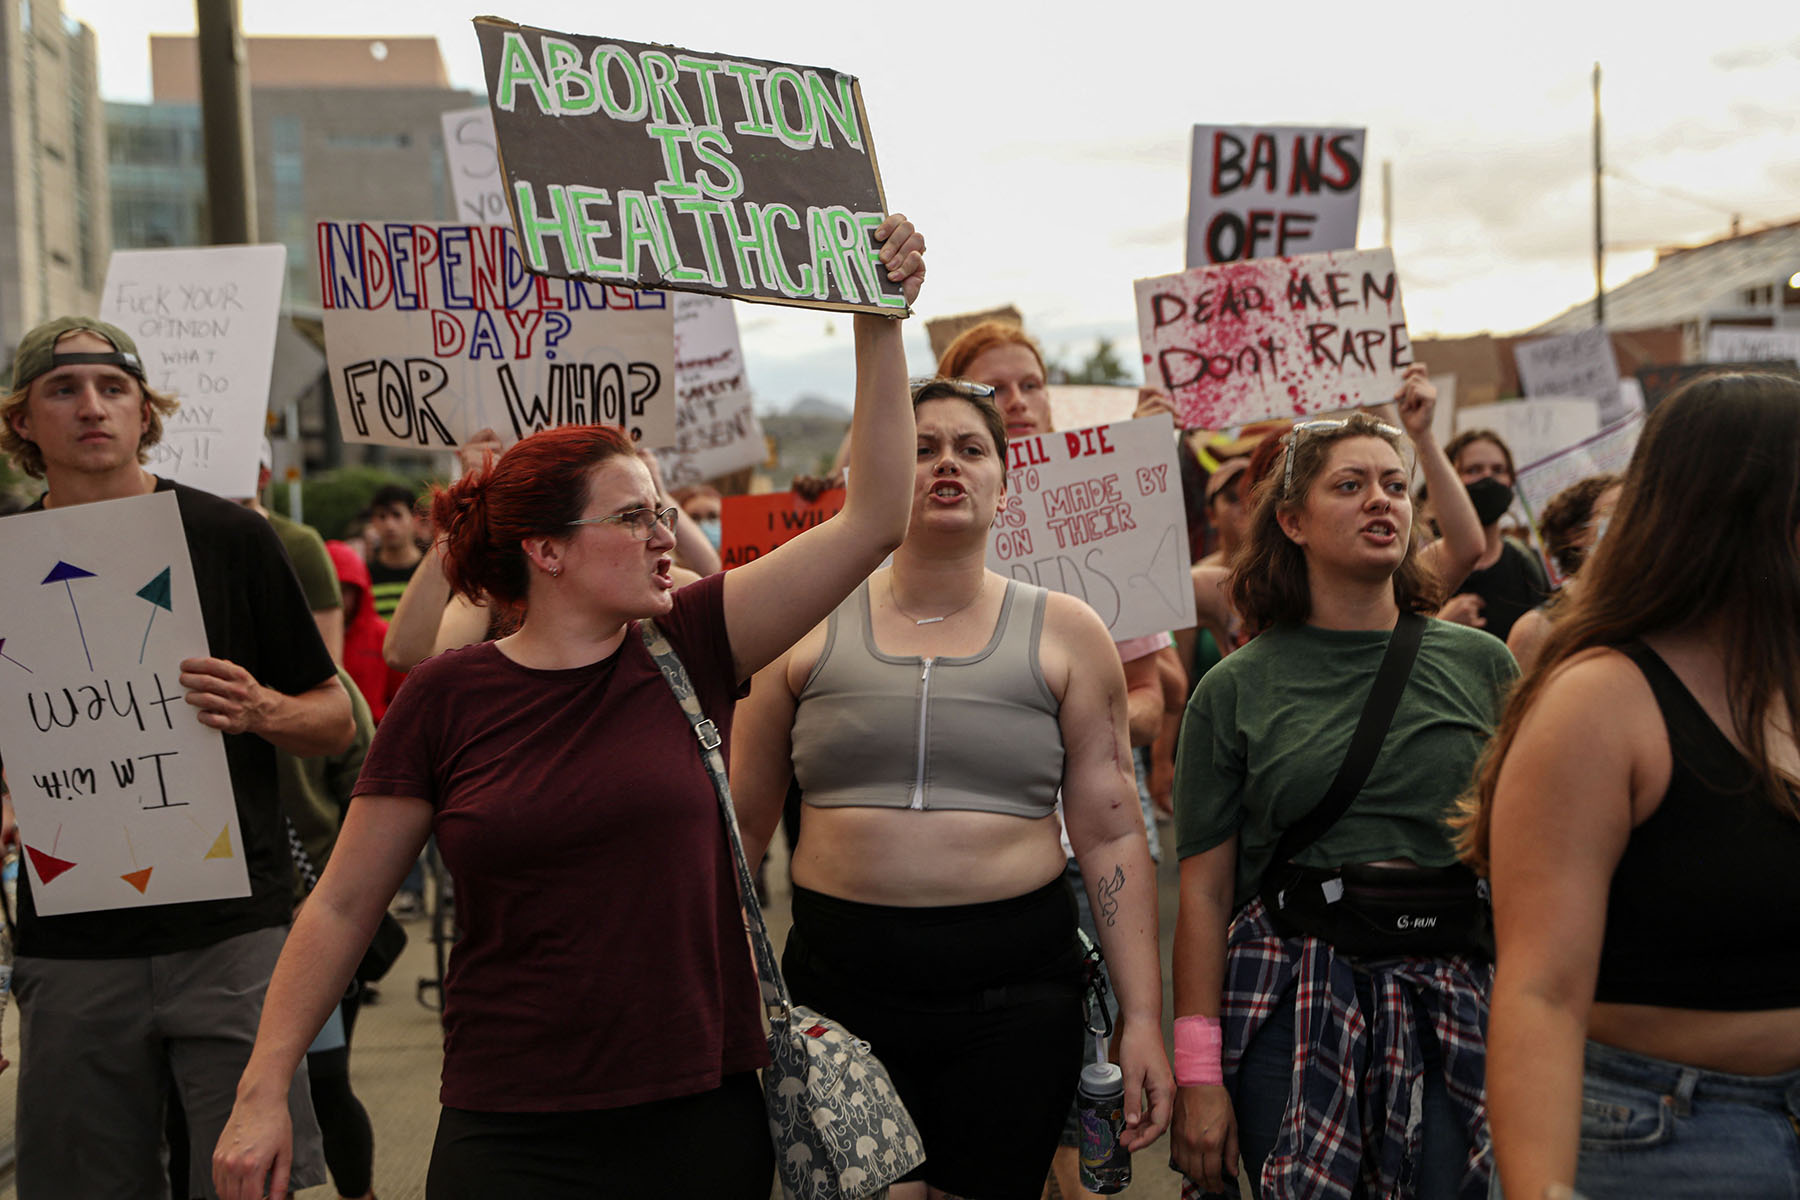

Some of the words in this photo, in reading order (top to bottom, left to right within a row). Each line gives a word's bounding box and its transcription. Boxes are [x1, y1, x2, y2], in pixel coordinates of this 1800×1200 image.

[497, 33, 865, 154] ABORTION
[646, 123, 744, 200] IS
[1210, 131, 1362, 197] BANS
[514, 181, 905, 308] HEALTHCARE
[1205, 210, 1318, 265] OFF
[178, 281, 244, 313] YOUR
[1151, 282, 1266, 326] DEAD
[1287, 270, 1397, 312] MEN
[138, 317, 232, 340] OPINION
[431, 310, 573, 360] DAY?
[1306, 323, 1413, 371] RAPE
[161, 350, 217, 366] WHAT
[199, 373, 230, 394] DO
[343, 358, 458, 447] FOR
[496, 362, 662, 442] WHO?
[178, 405, 214, 425] MY
[1064, 425, 1115, 460] DIE
[1007, 468, 1040, 494] TO
[1042, 473, 1122, 519] MADE
[1136, 463, 1168, 497] BY
[767, 511, 775, 532] I
[995, 528, 1034, 561] ON
[1047, 502, 1136, 549] THEIR
